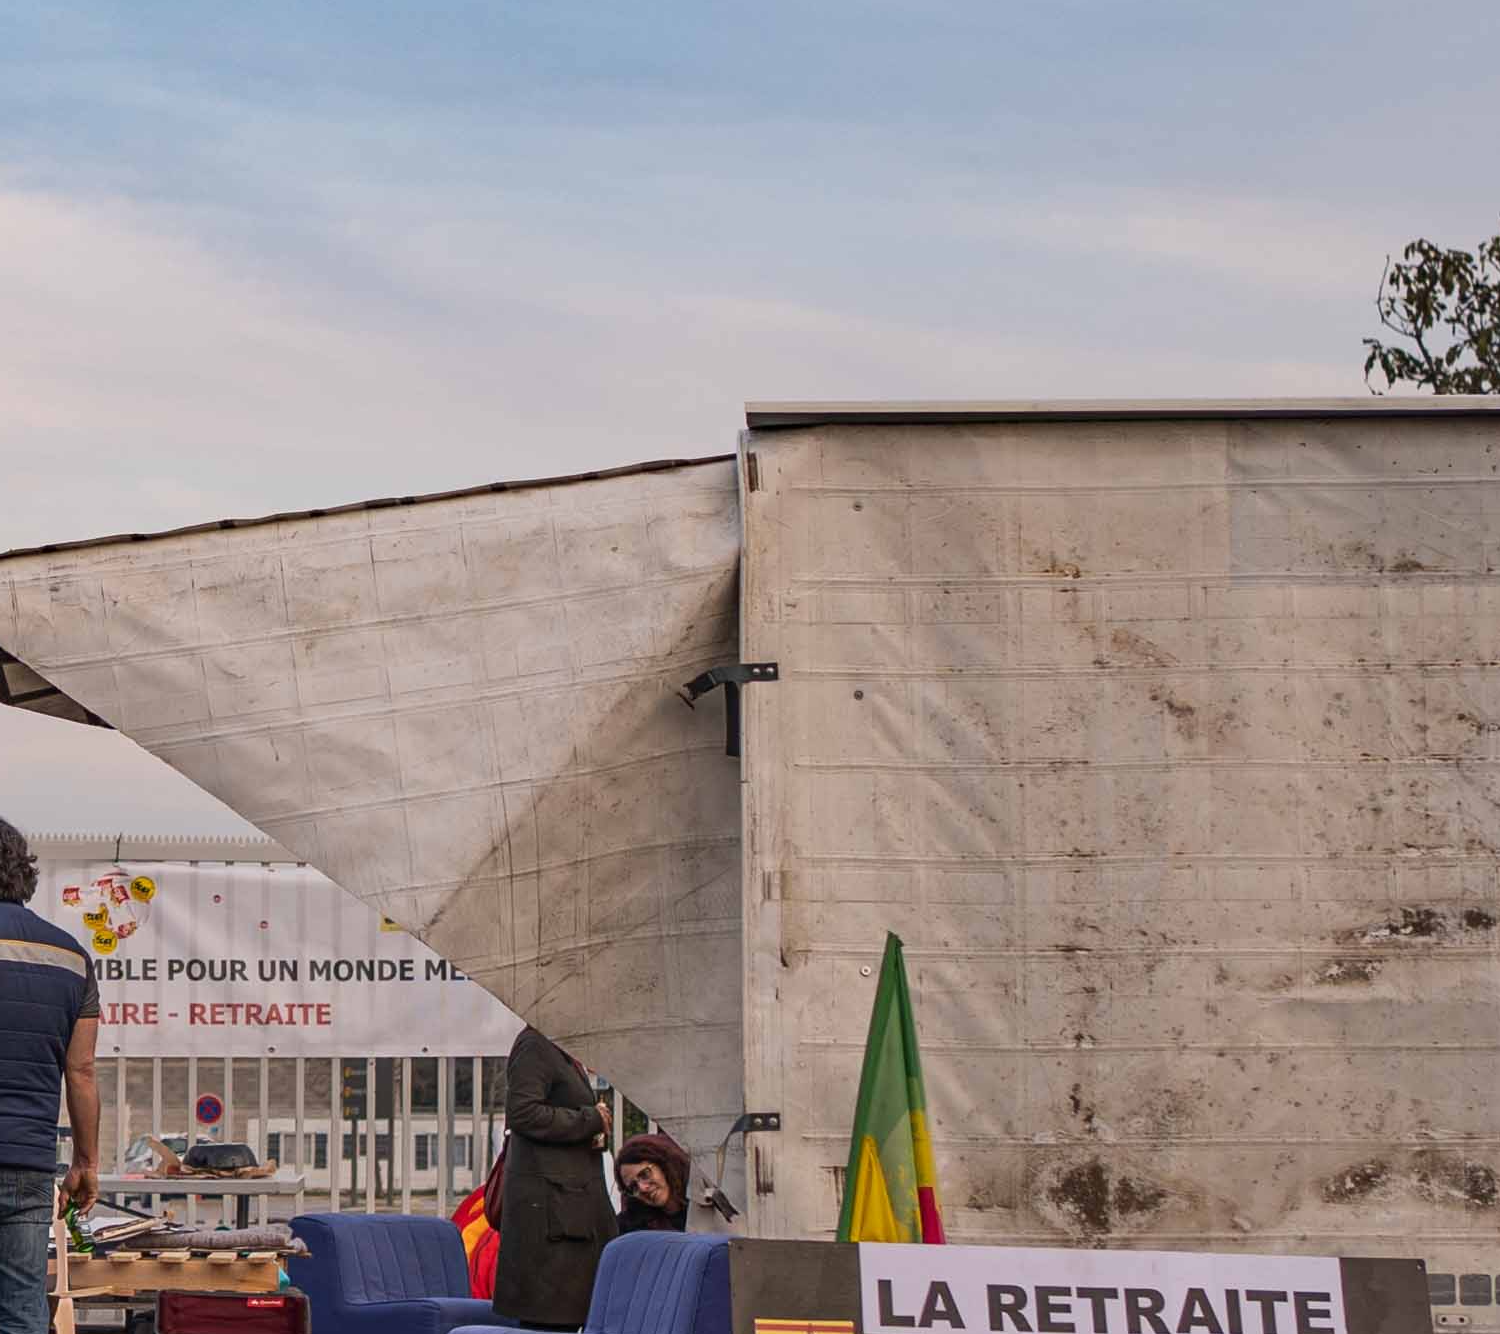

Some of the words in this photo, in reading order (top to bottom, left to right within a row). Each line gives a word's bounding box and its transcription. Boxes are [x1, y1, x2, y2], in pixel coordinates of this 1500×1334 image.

[167, 958, 249, 982] POUR
[258, 959, 298, 981] UN
[309, 958, 414, 982] MONDE
[189, 1002, 332, 1026] RETRAITE
[876, 1278, 966, 1330] LA
